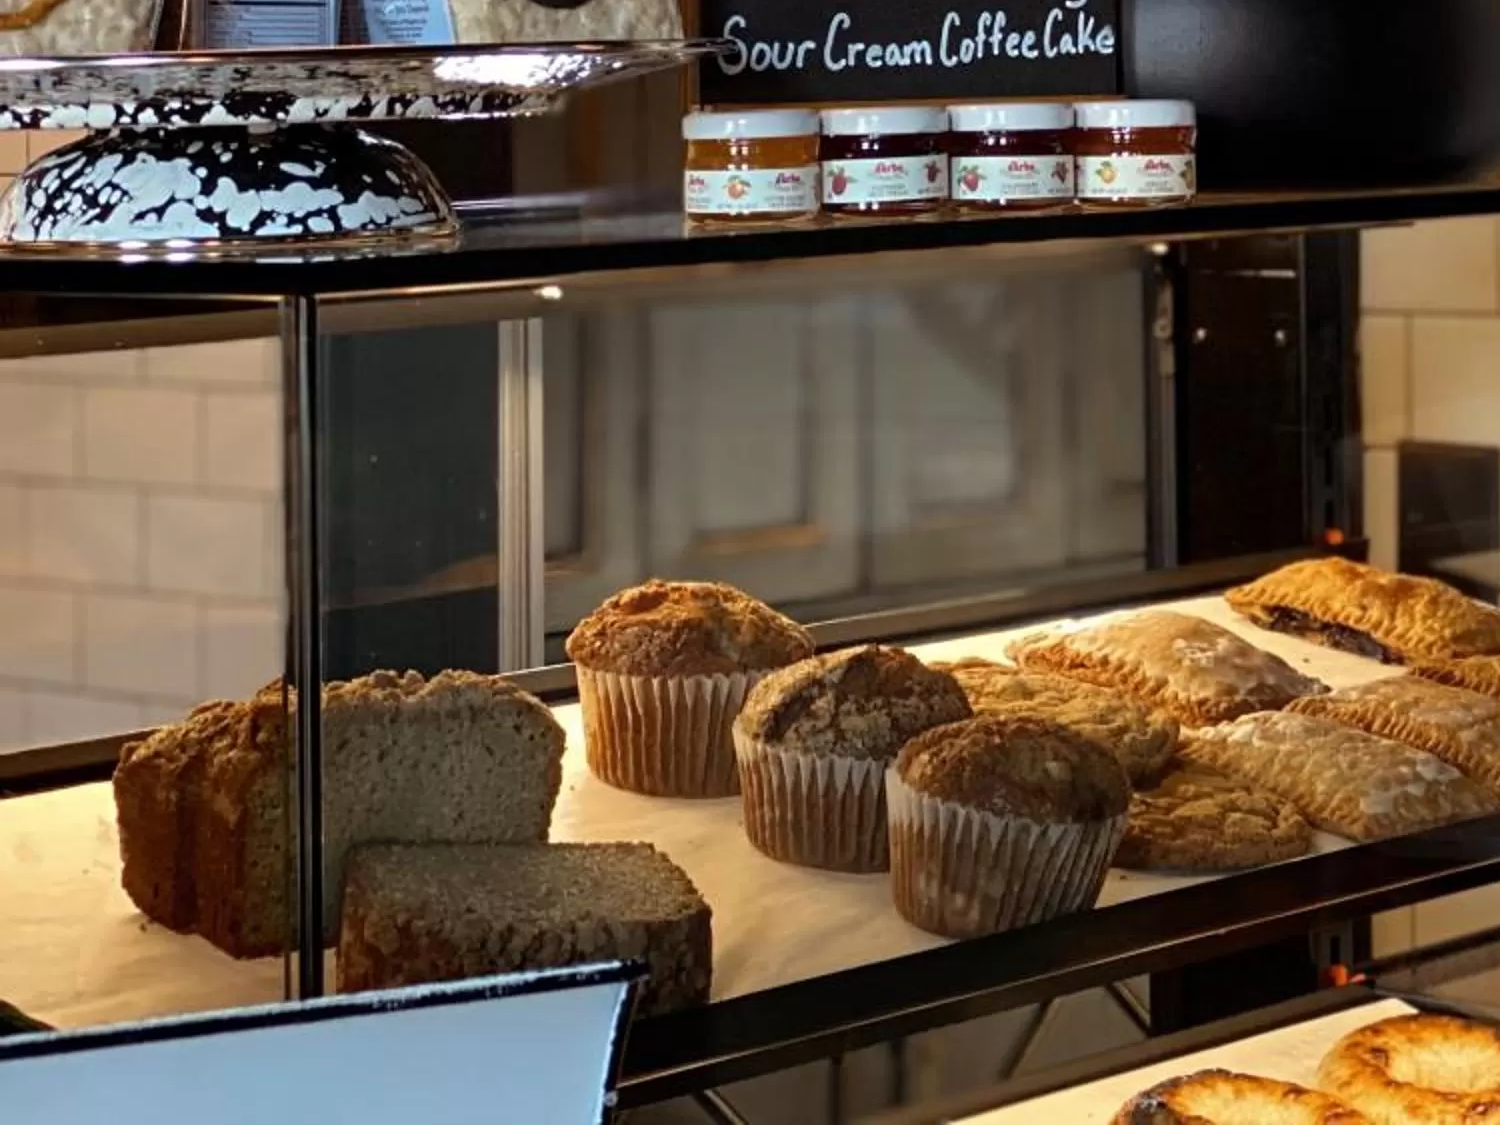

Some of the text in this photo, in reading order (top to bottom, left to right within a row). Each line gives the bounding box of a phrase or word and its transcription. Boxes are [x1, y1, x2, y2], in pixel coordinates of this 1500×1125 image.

[716, 8, 1116, 75] Sour Cream Coffee Cake
